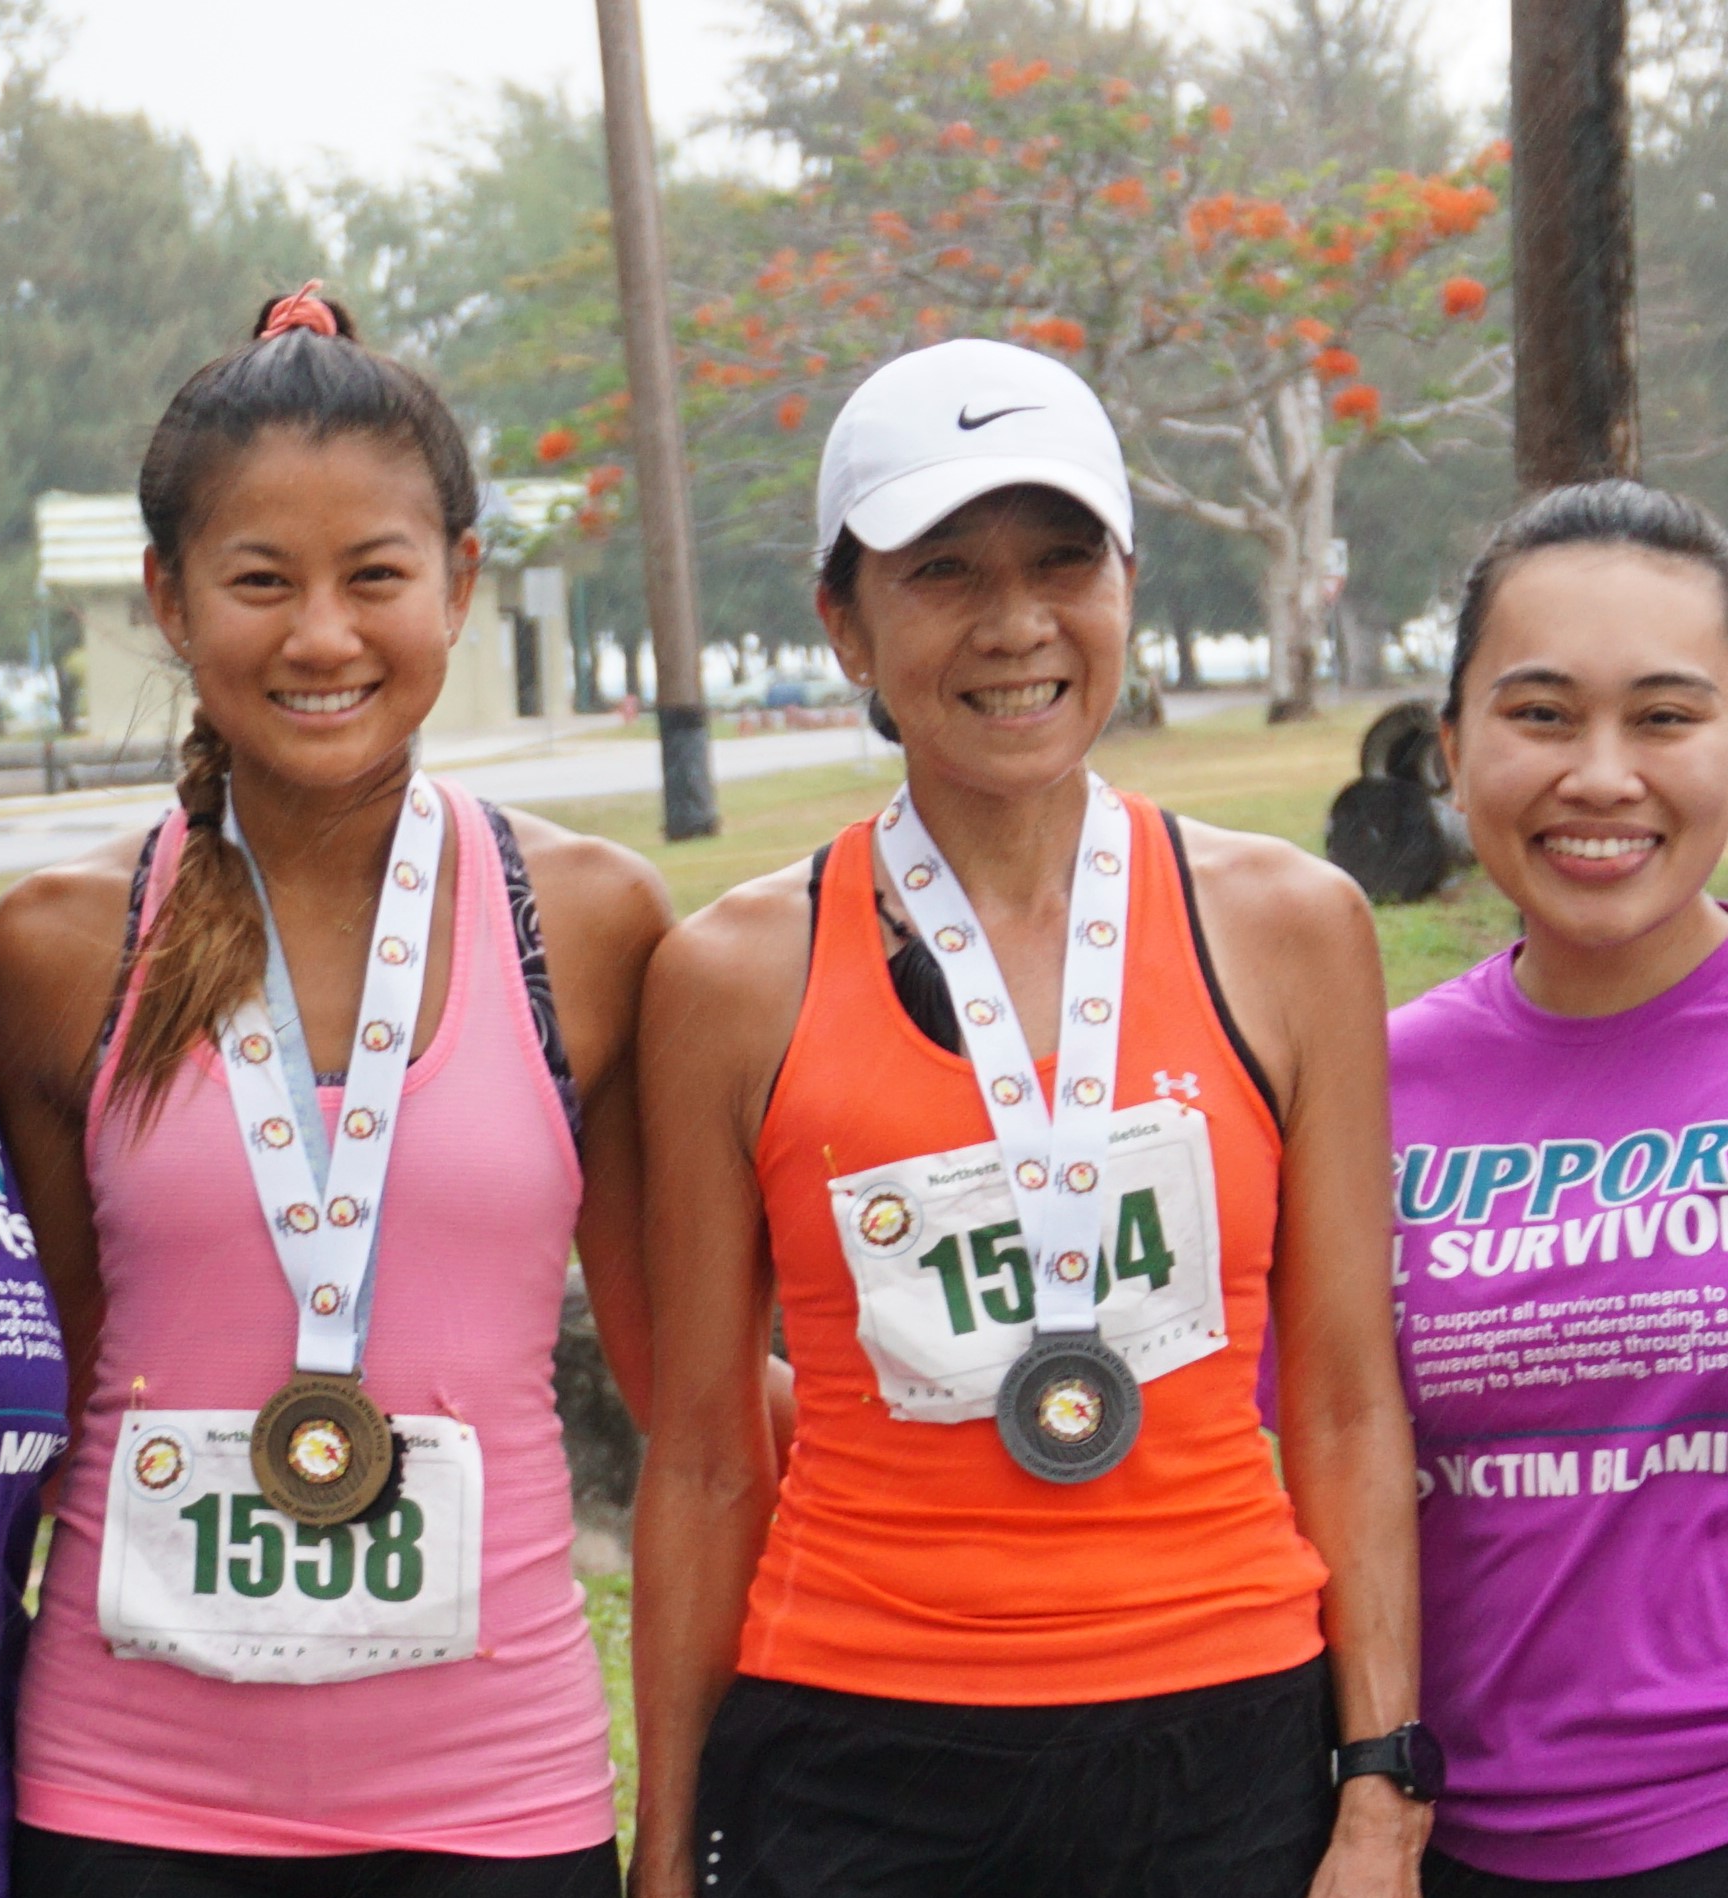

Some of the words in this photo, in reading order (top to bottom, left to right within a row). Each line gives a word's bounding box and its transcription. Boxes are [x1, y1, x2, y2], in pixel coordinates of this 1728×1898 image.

[919, 1187, 1176, 1336] 154
[1411, 1313, 1431, 1333] To
[1433, 1305, 1508, 1332] support
[1511, 1301, 1536, 1321] all
[1538, 1295, 1625, 1319] survivors
[1629, 1288, 1699, 1308] means
[1702, 1284, 1727, 1303] to
[1412, 1322, 1559, 1355] encouragement,
[1562, 1307, 1710, 1338] understanding,
[1415, 1350, 1520, 1377] unwavering
[1523, 1340, 1621, 1364] assistance
[1488, 1371, 1509, 1389] to
[1511, 1364, 1574, 1387] safety,
[1574, 1357, 1652, 1380] healing,
[1654, 1352, 1693, 1374] and
[179, 1492, 424, 1602] 1558
